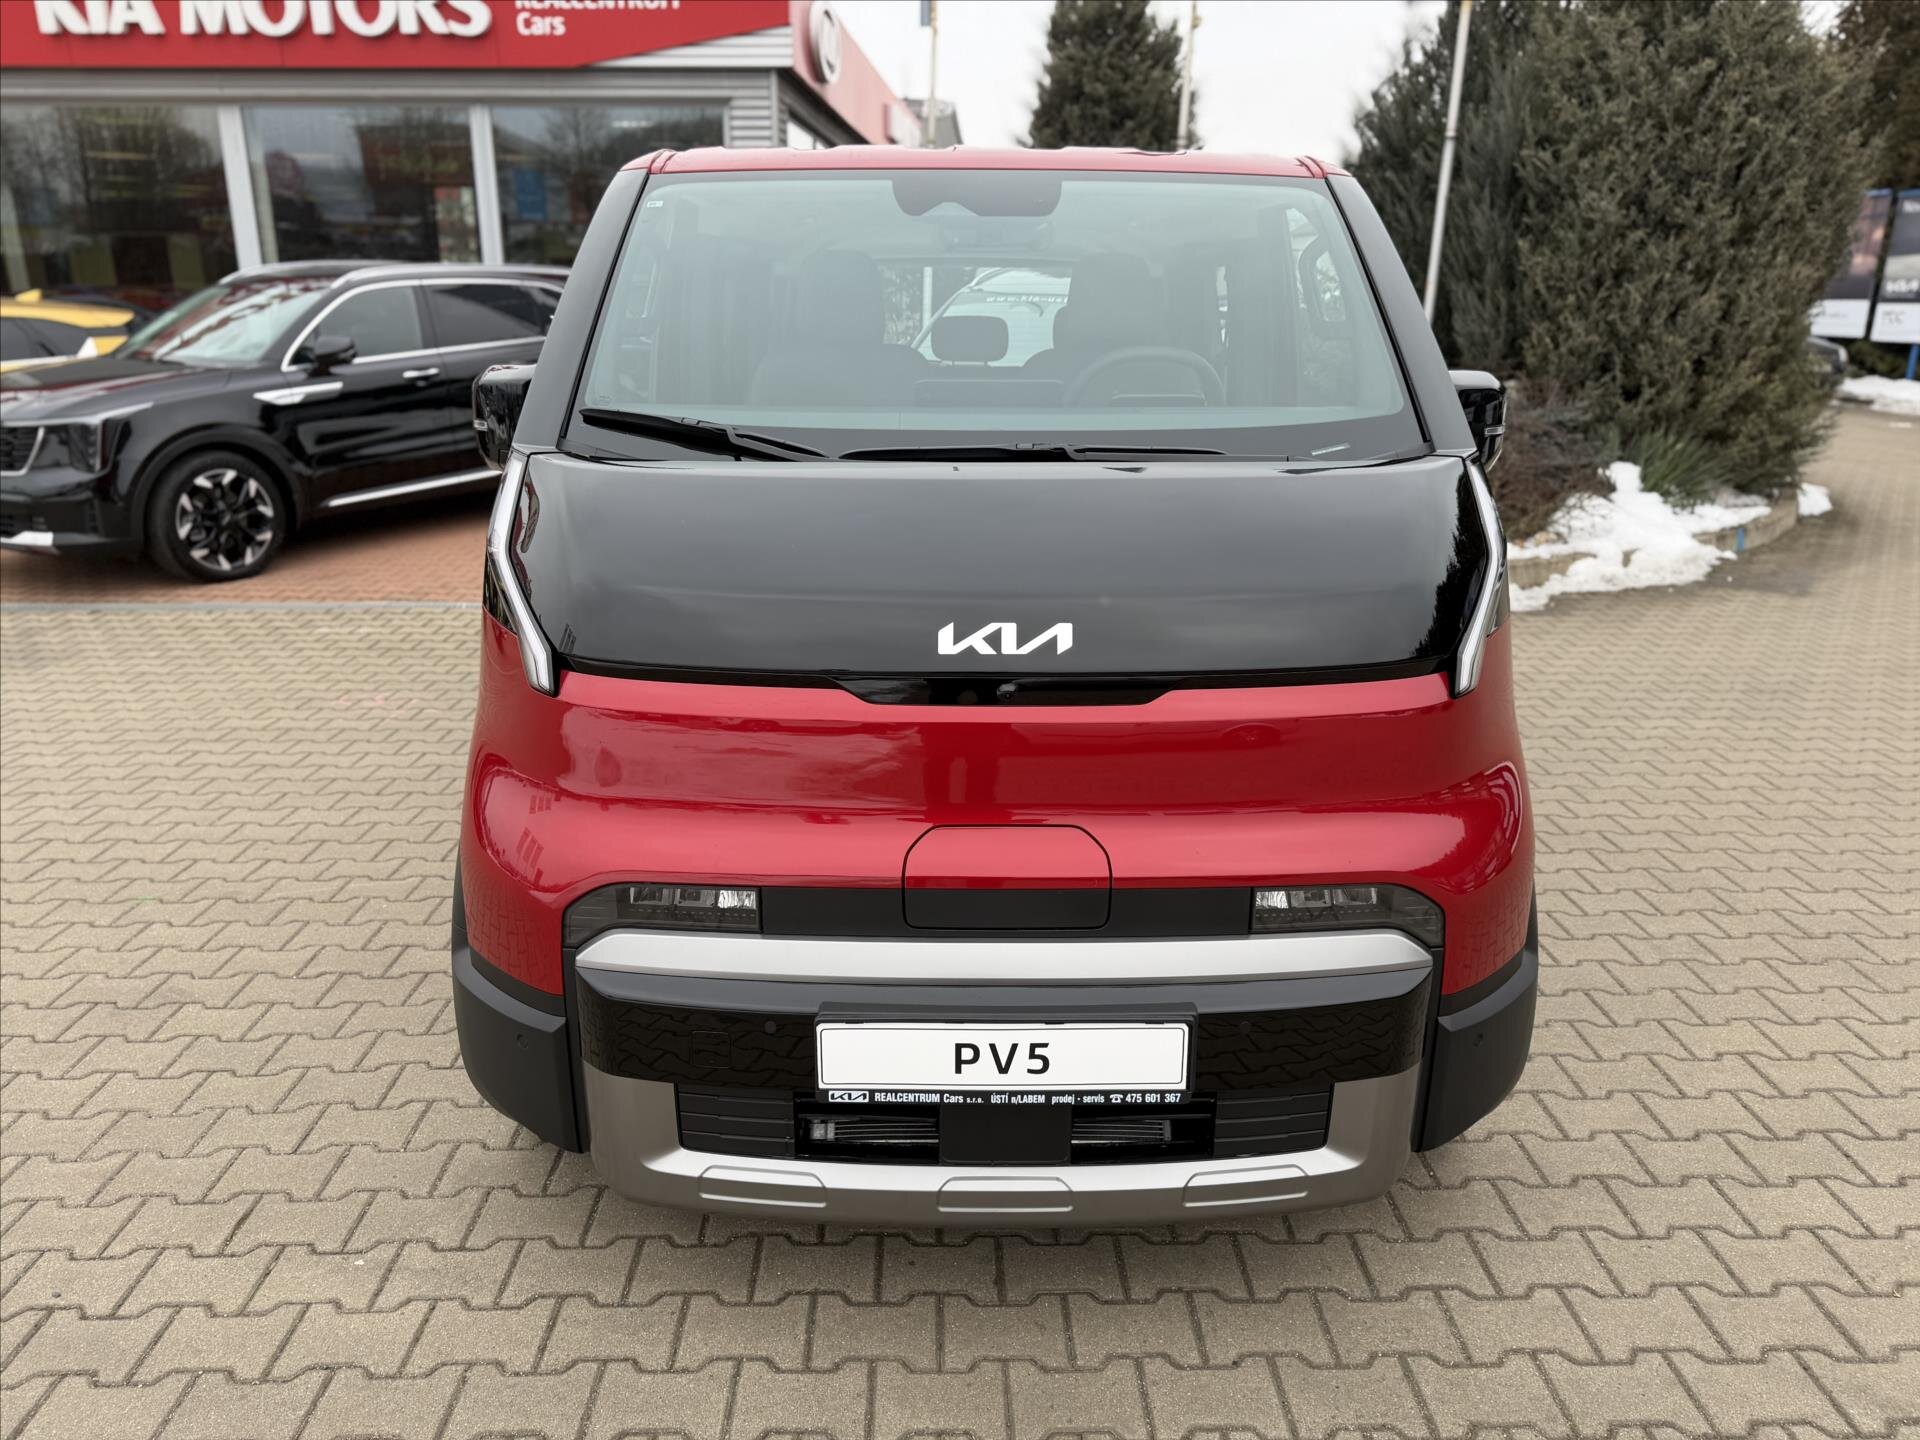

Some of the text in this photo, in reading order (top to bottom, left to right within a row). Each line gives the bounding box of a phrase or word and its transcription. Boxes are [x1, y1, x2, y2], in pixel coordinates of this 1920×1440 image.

[516, 11, 566, 36] Cars
[937, 622, 1073, 655] KIA
[954, 1042, 1051, 1075] PV5
[874, 1092, 940, 1103] REALCENTRUM
[943, 1093, 964, 1104] Cars
[990, 1092, 1009, 1105] ÚSTÍ
[1011, 1094, 1046, 1105] n/LABEM
[1051, 1093, 1075, 1105] prodej
[1082, 1093, 1105, 1104] servis
[1125, 1093, 1142, 1103] 475
[1145, 1093, 1161, 1103] 601
[1164, 1093, 1181, 1103] 367
